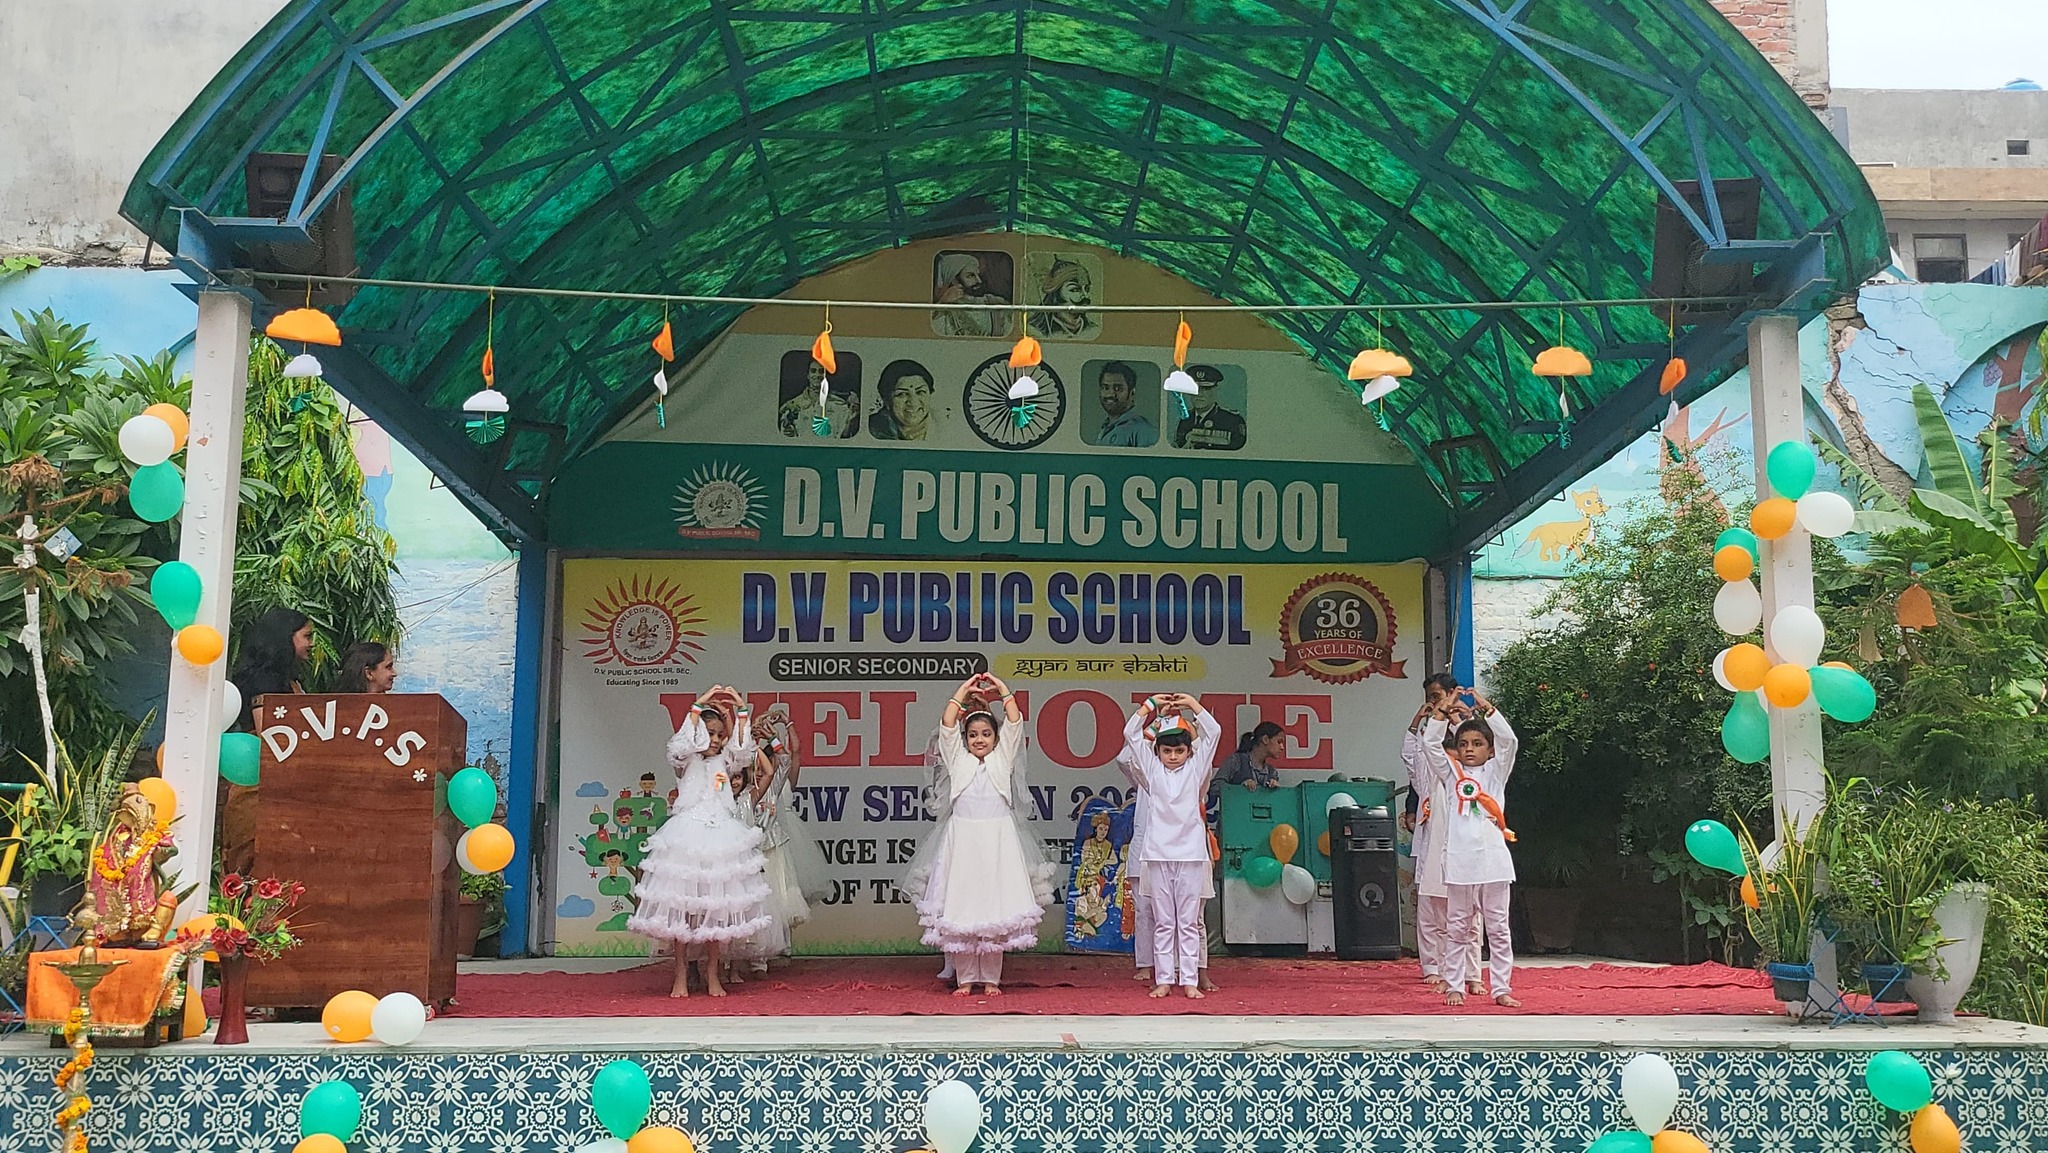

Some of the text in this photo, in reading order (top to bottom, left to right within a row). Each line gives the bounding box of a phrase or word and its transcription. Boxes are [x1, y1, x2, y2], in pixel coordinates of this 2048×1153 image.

[782, 466, 1348, 554] D.V. PUBLIC SCHOOL
[742, 571, 1251, 646] D.V. PUBLIC SCHOOL
[1316, 598, 1361, 628] 36
[614, 606, 673, 642] KNOWLEDGE IS POWER
[1314, 629, 1363, 639] YEARS OF
[1297, 643, 1383, 660] EXCELLENCE
[607, 669, 632, 677] PUBLIC
[633, 667, 662, 676] SCHOOL
[777, 658, 979, 676] SENIOR SECONDARY
[1013, 653, 1189, 678] gyan aur shakti
[606, 678, 679, 688] Educating Since 1989
